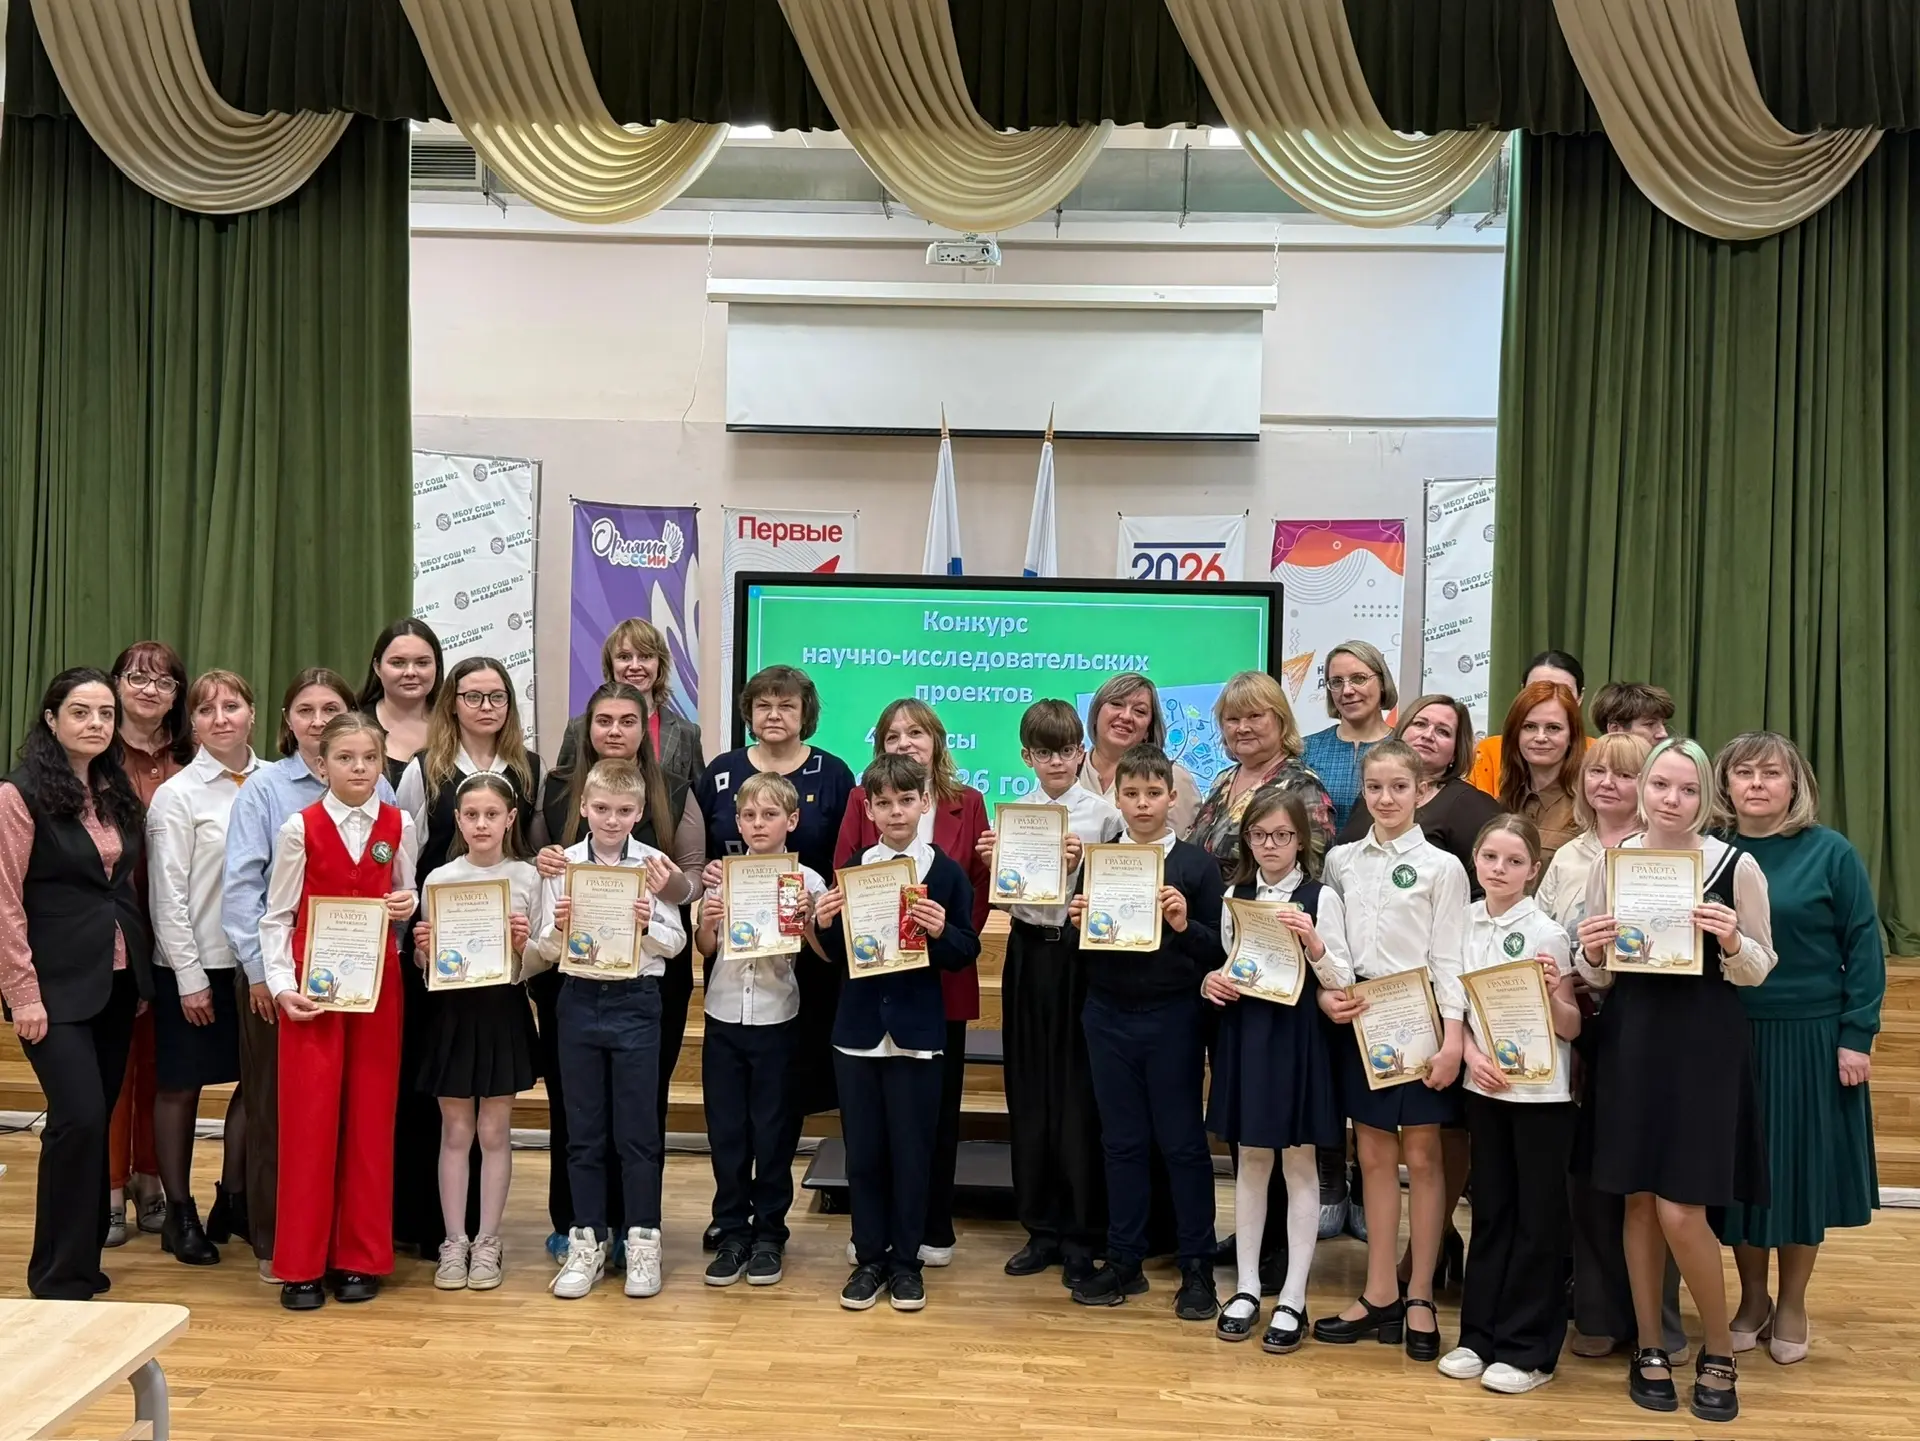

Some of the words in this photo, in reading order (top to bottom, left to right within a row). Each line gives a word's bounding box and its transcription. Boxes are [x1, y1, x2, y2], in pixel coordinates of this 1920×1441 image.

[425, 476, 444, 487] СОШ
[1442, 496, 1466, 510] МБОУ
[1467, 488, 1487, 501] СОШ
[452, 507, 473, 519] МБОУ
[475, 503, 492, 513] СОШ
[493, 498, 506, 508] №2
[506, 530, 525, 543] МБОУ
[738, 515, 843, 548] Первые
[593, 518, 668, 559] Орлята
[1442, 538, 1457, 549] №2
[420, 556, 442, 568] МБОУ
[443, 550, 461, 561] СОШ
[463, 546, 476, 556] №2
[1132, 552, 1226, 581] 2026
[470, 585, 491, 597] МБОУ
[492, 579, 510, 590] СОШ
[511, 575, 524, 584] №2
[1459, 573, 1482, 587] МБОУ
[425, 601, 440, 612] №2
[922, 610, 1029, 638] Конкурс
[1439, 620, 1458, 631] СОШ
[1459, 616, 1473, 626] №2
[461, 628, 480, 639] СОШ
[480, 622, 494, 633] №2
[509, 650, 527, 661] СОШ
[803, 645, 1150, 673] научно-исследовательских
[915, 683, 1034, 706] проектов
[1474, 690, 1488, 701] №2
[956, 768, 990, 795] 26
[1013, 818, 1048, 826] ГРАМОТА
[1104, 858, 1143, 866] ГРАМОТА
[742, 867, 778, 875] ГРАМОТА
[1631, 865, 1677, 875] ГРАМОТА
[585, 879, 624, 888] ГРАМОТА
[858, 875, 896, 886] ГРАМОТА
[449, 892, 488, 902] ГРАМОТА
[329, 911, 368, 921] ГРАМОТА
[1367, 980, 1408, 995] ГРАМОТА
[1486, 978, 1526, 989] ГРАМОТА
